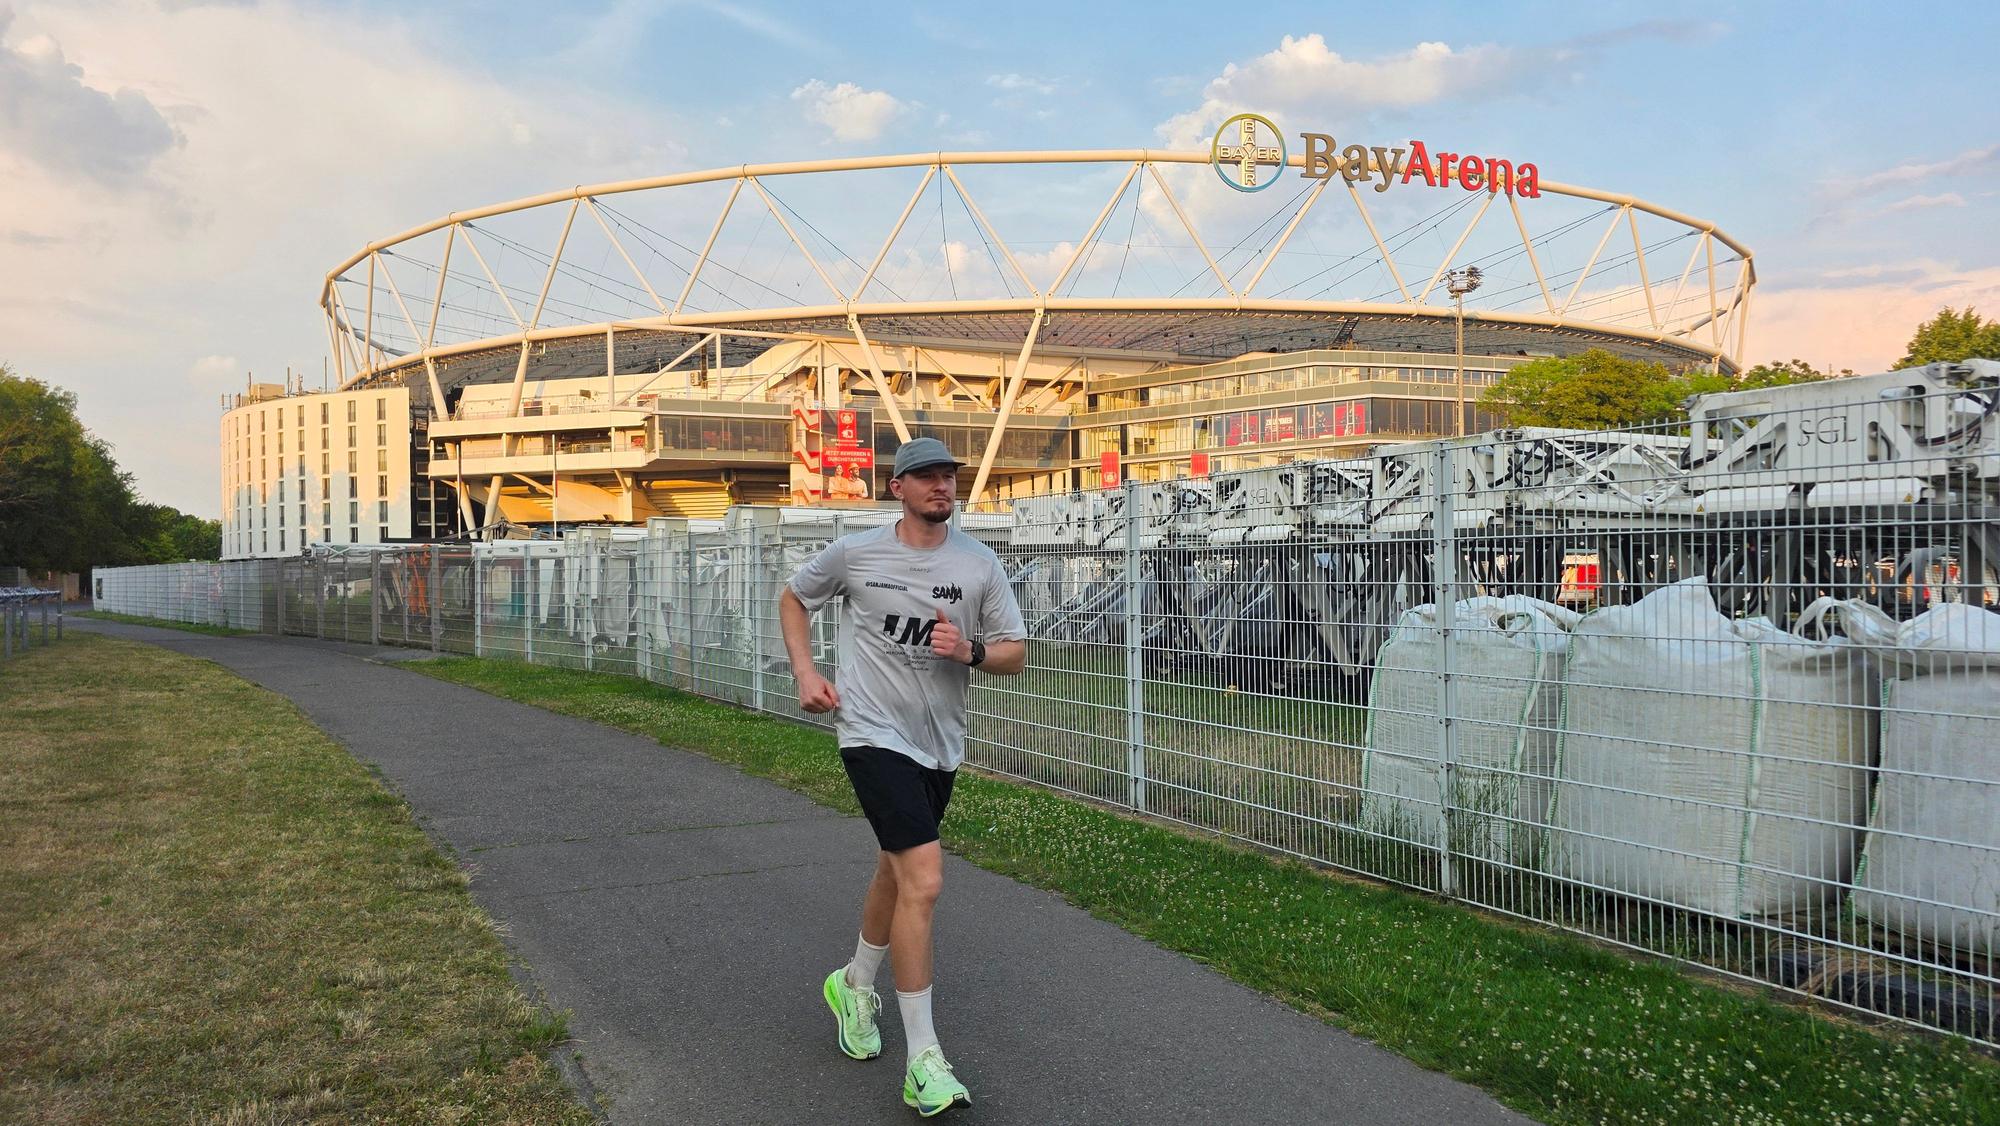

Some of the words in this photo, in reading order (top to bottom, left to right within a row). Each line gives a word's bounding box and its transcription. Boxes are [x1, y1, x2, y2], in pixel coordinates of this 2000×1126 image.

[1220, 146, 1280, 160] BAYER
[1244, 121, 1256, 185] BAYER
[1300, 132, 1541, 199] BayArena
[1797, 415, 1857, 447] SGL
